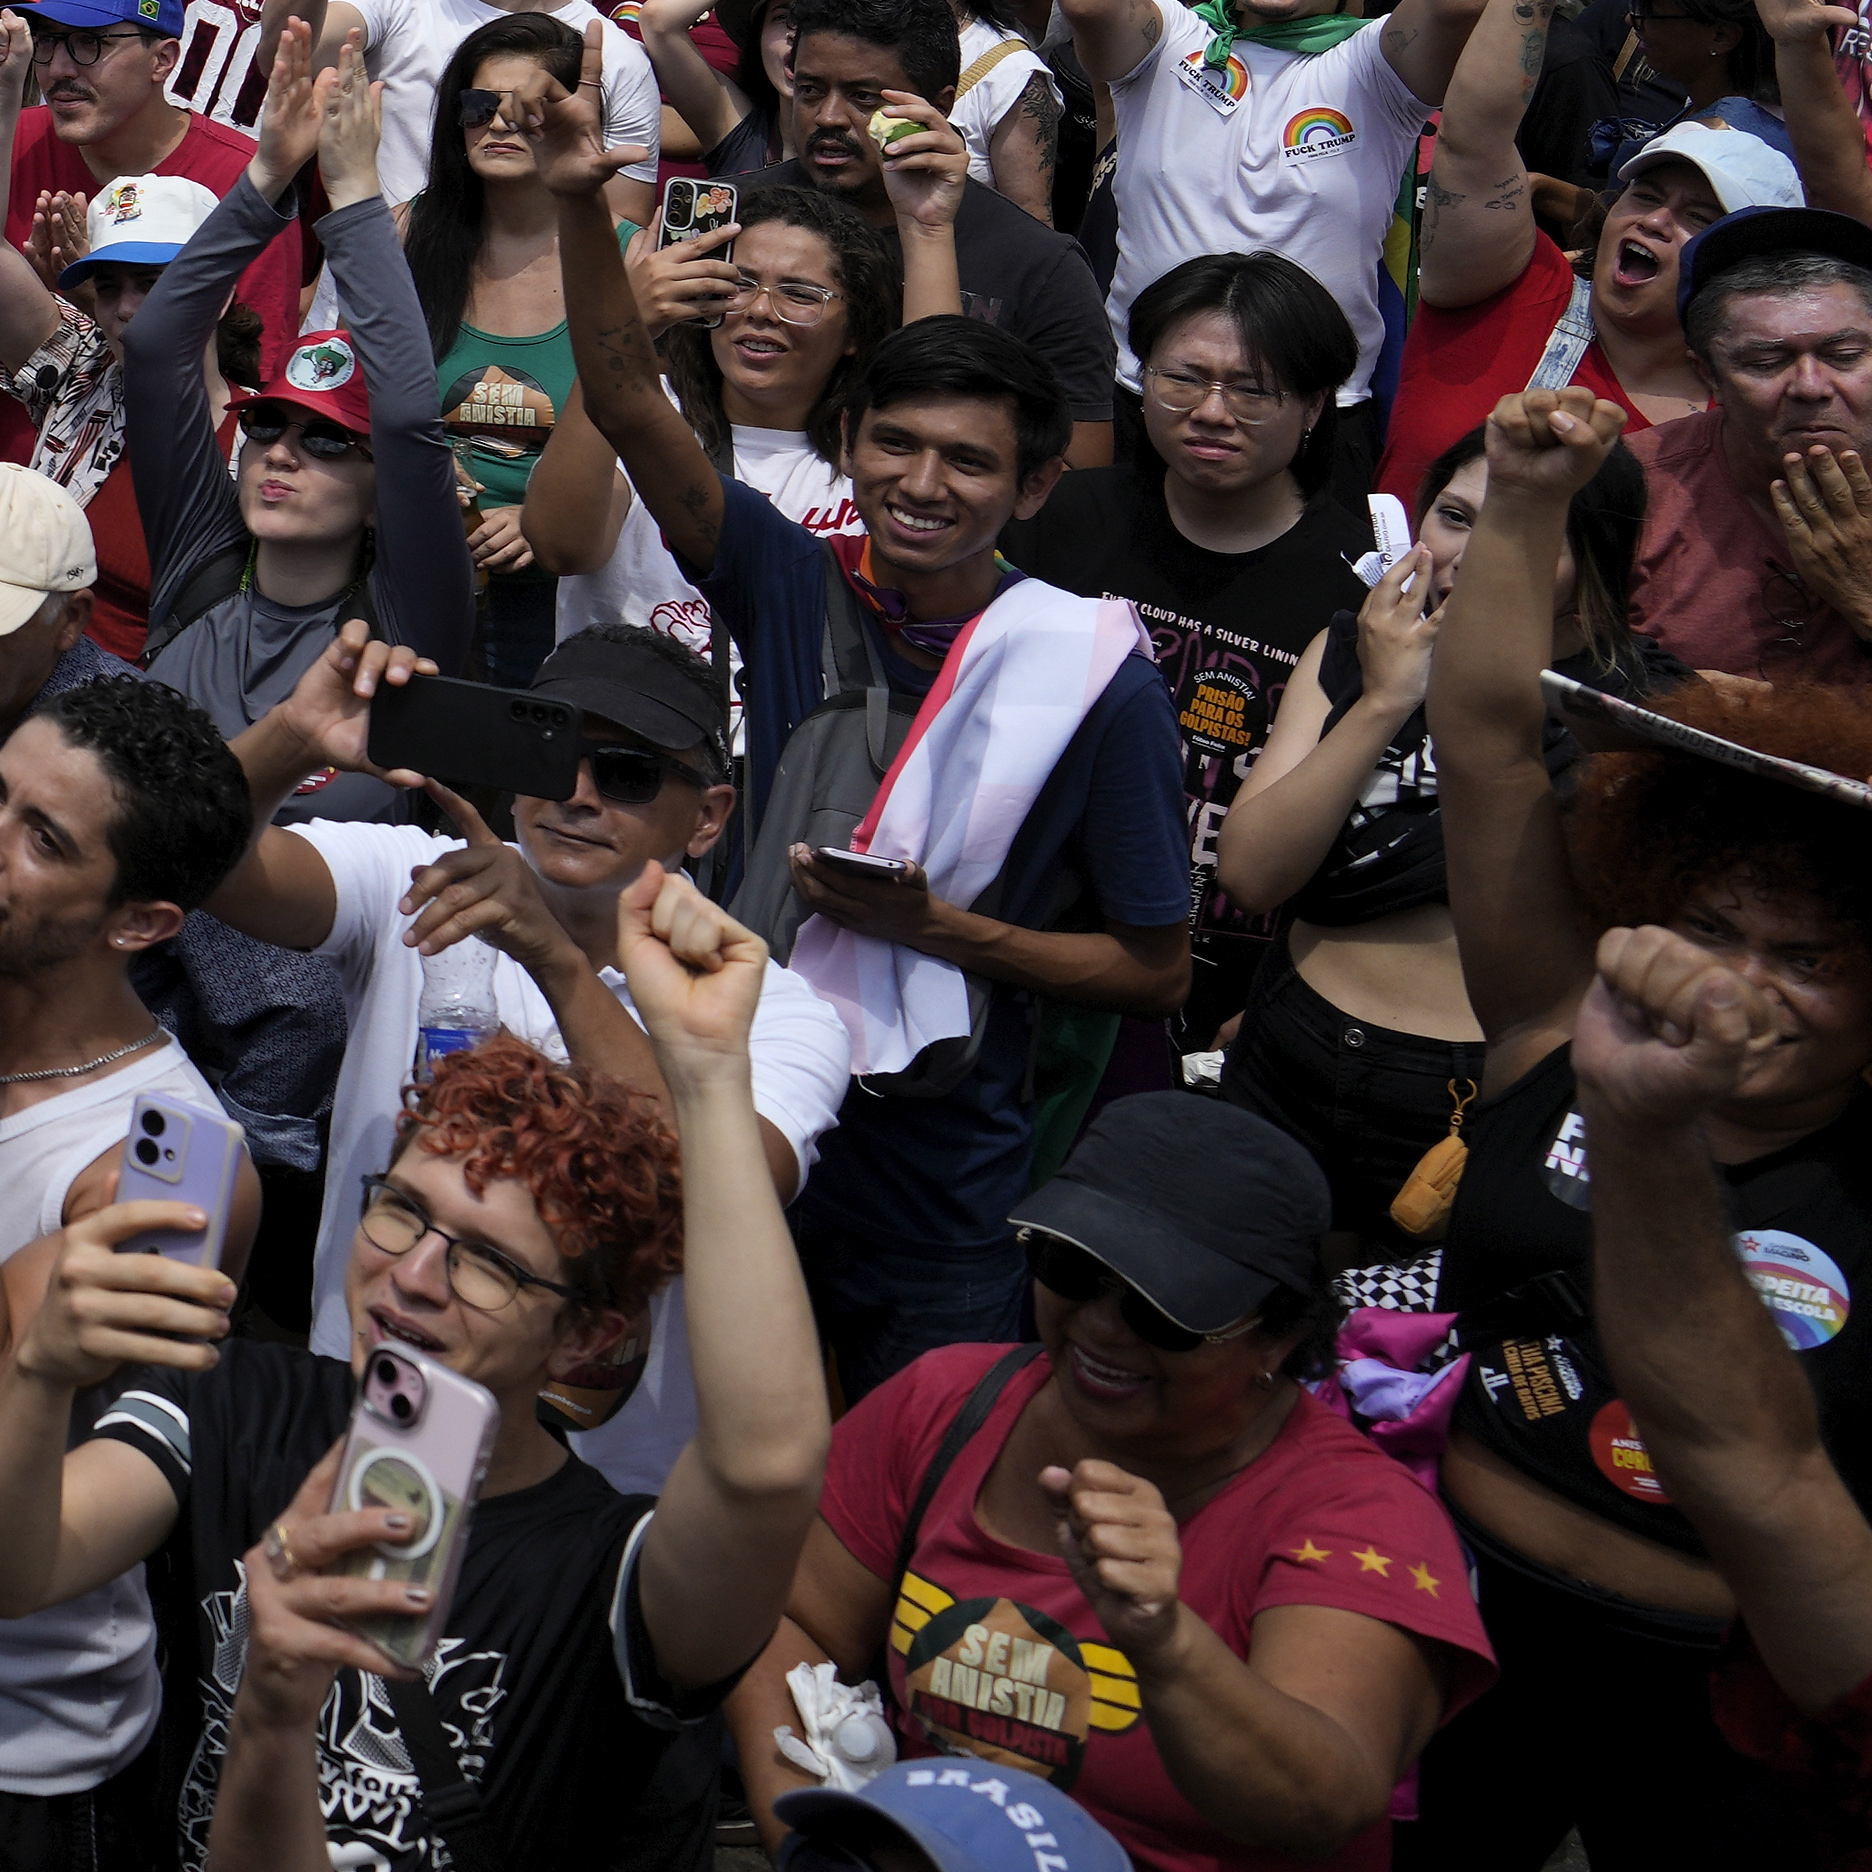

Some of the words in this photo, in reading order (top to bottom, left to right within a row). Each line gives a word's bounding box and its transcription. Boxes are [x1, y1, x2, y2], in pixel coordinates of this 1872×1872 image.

[1177, 59, 1206, 85] FUCK
[1202, 77, 1237, 110] TRUMP
[1284, 143, 1317, 159] FUCK
[1317, 133, 1357, 151] TRUMP
[473, 381, 525, 408] SEM
[459, 405, 537, 427] ANISTIA
[1140, 603, 1178, 626] CLOUD
[1178, 612, 1202, 631] HAS
[1203, 620, 1214, 635] A
[1215, 627, 1259, 652] SILVER
[1259, 640, 1302, 665] LININ
[1193, 670, 1216, 685] SEM
[1216, 670, 1256, 702] ANISTIA!
[1197, 684, 1246, 712] PRISÃO
[1179, 712, 1249, 748] GOLPISTAS!
[1192, 701, 1222, 723] PARA
[1223, 709, 1245, 729] OS
[1527, 1364, 1566, 1417] PISCINA
[961, 1624, 1055, 1688] SEM
[929, 1656, 1066, 1731] ANISTIA
